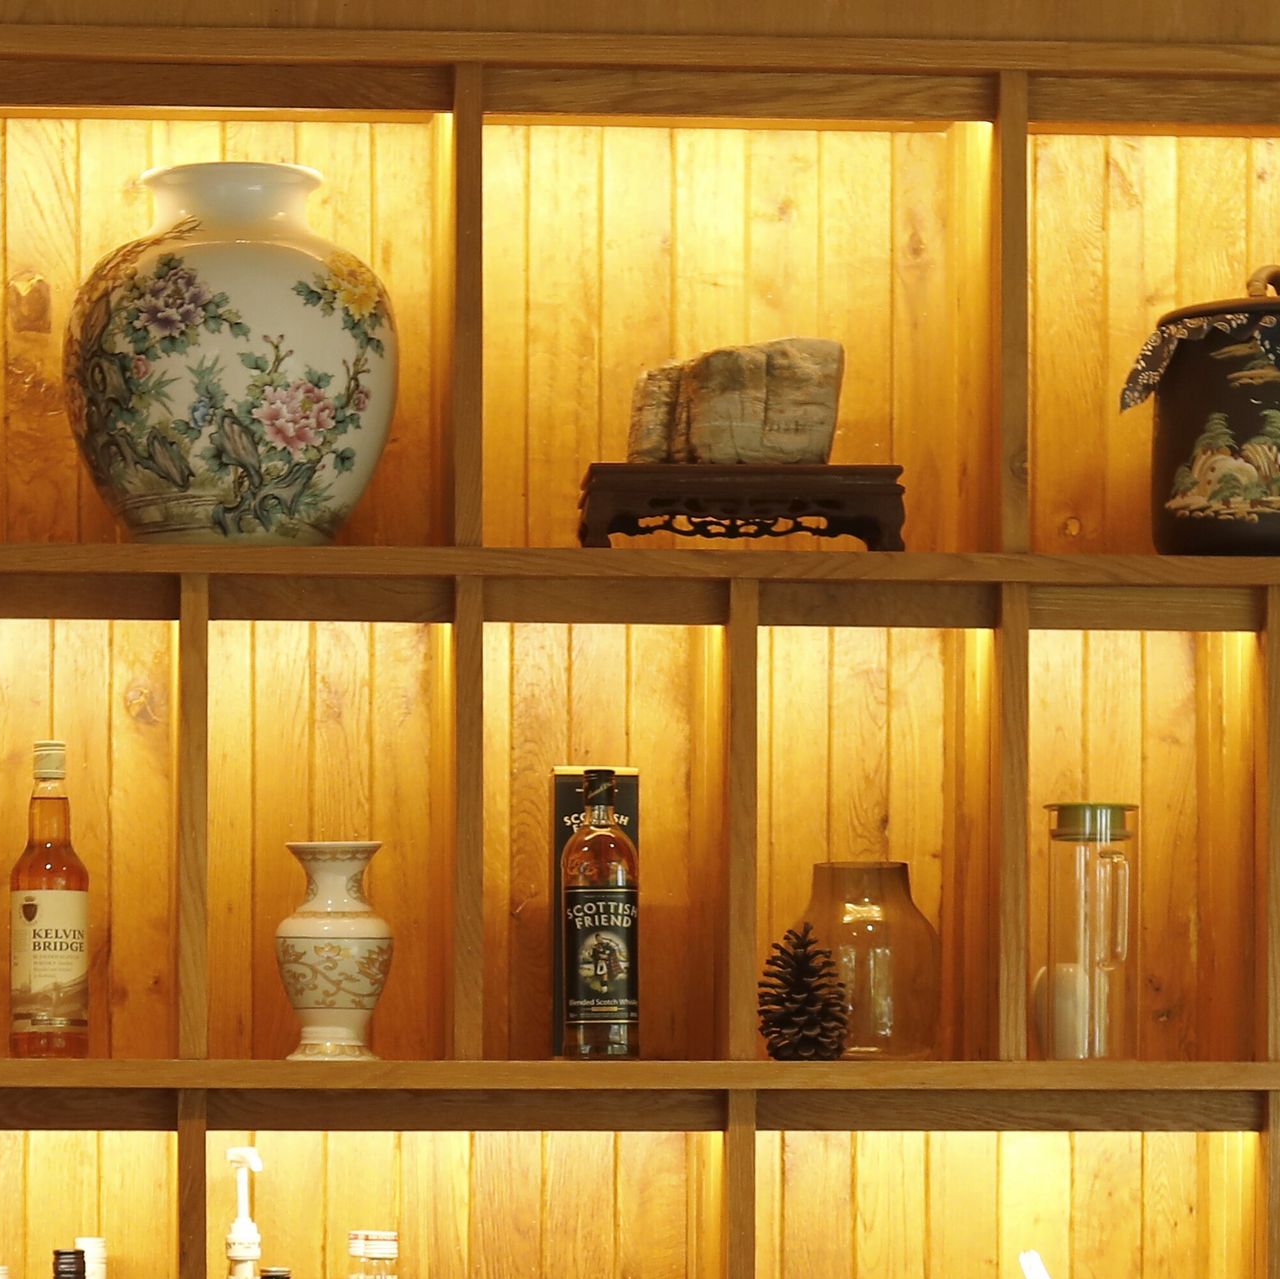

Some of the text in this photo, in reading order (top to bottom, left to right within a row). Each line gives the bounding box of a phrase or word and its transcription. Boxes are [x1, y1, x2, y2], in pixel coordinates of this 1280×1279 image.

[567, 902, 637, 919] SCOTTISH
[575, 914, 631, 929] FRIEND
[32, 928, 84, 940] KELVIN
[32, 941, 84, 952] BRIDGE
